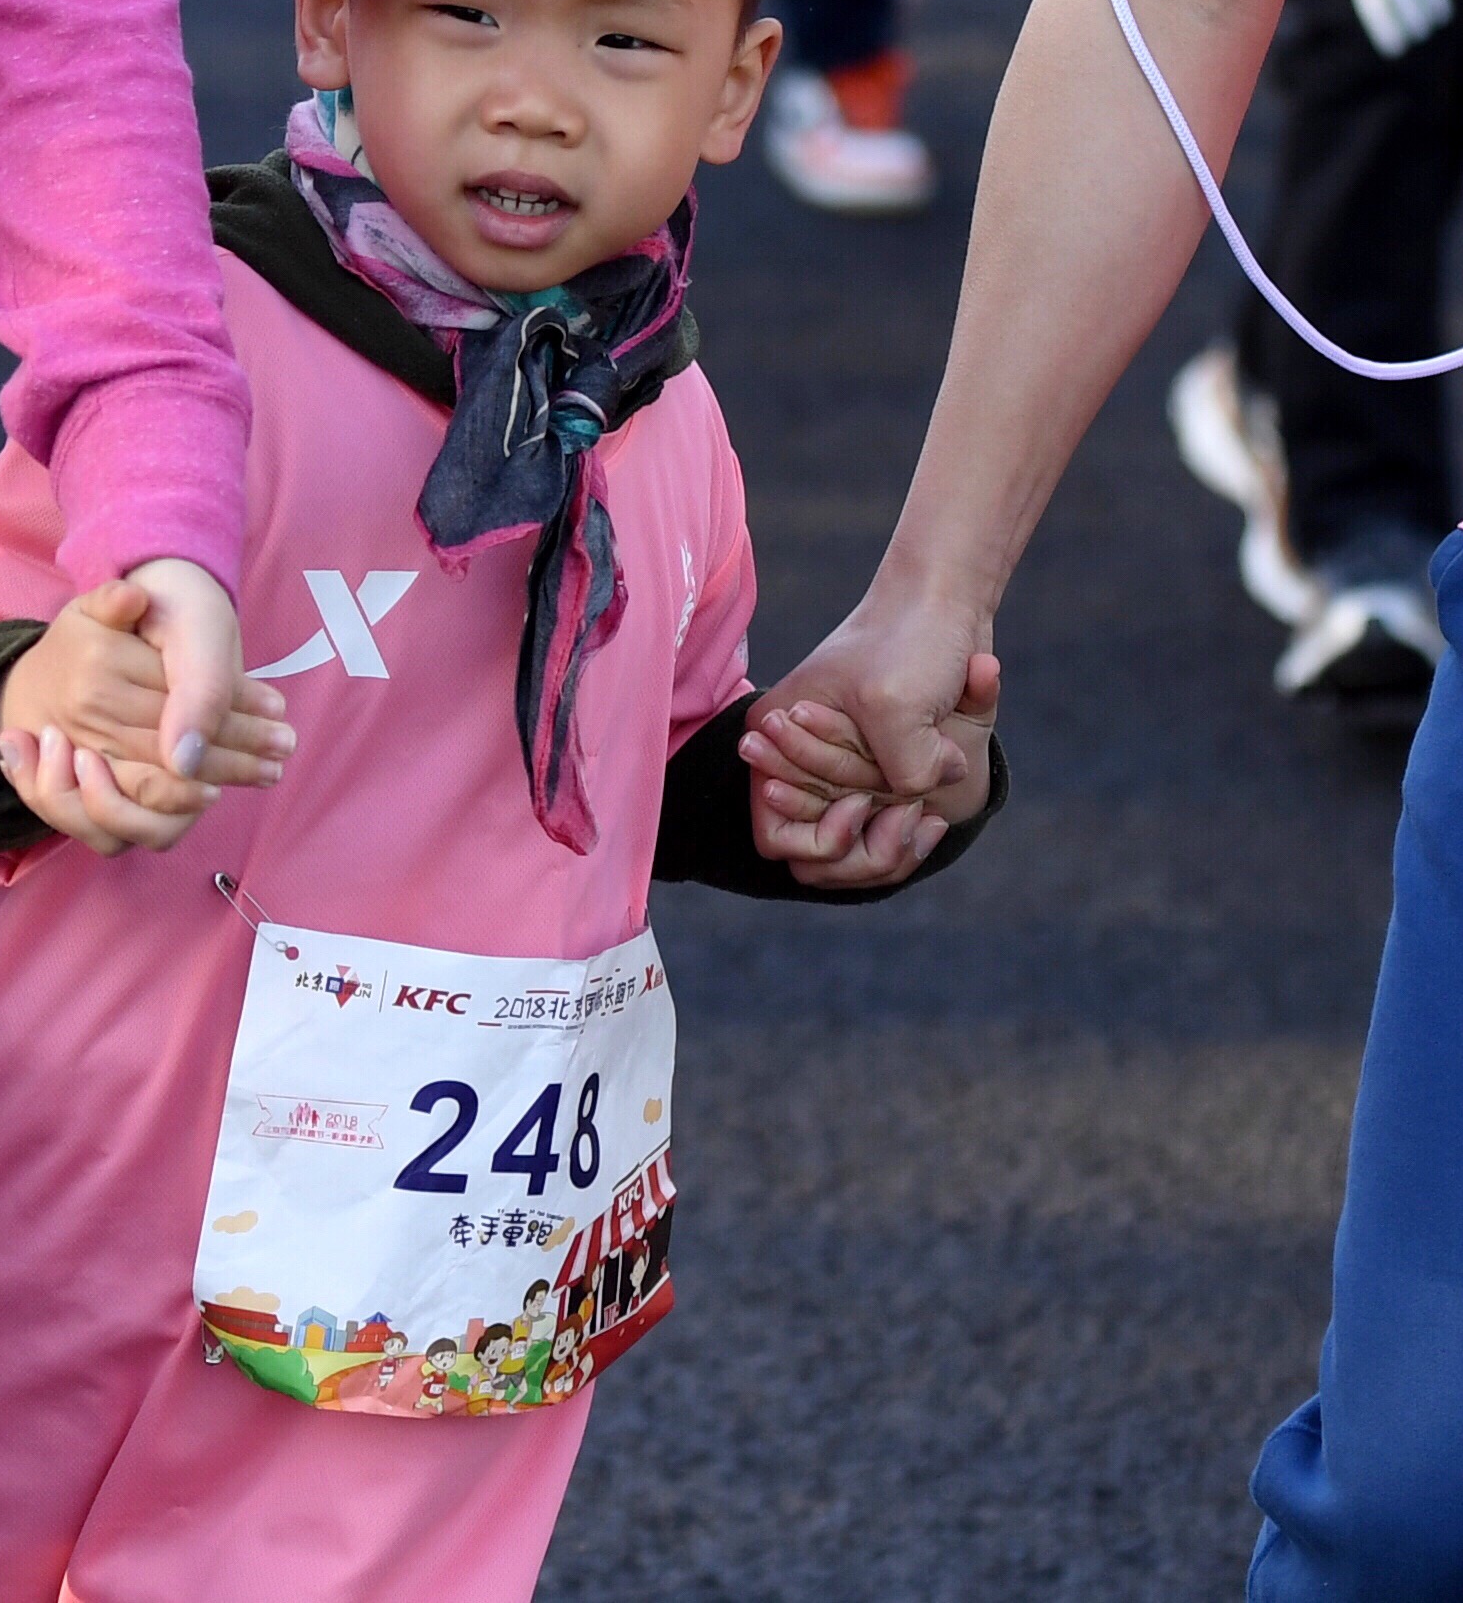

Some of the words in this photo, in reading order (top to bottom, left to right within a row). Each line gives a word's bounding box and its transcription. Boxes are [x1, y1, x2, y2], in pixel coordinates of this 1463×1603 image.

[392, 984, 473, 1016] KFC
[392, 1072, 602, 1197] 248
[617, 1180, 642, 1216] KFC
